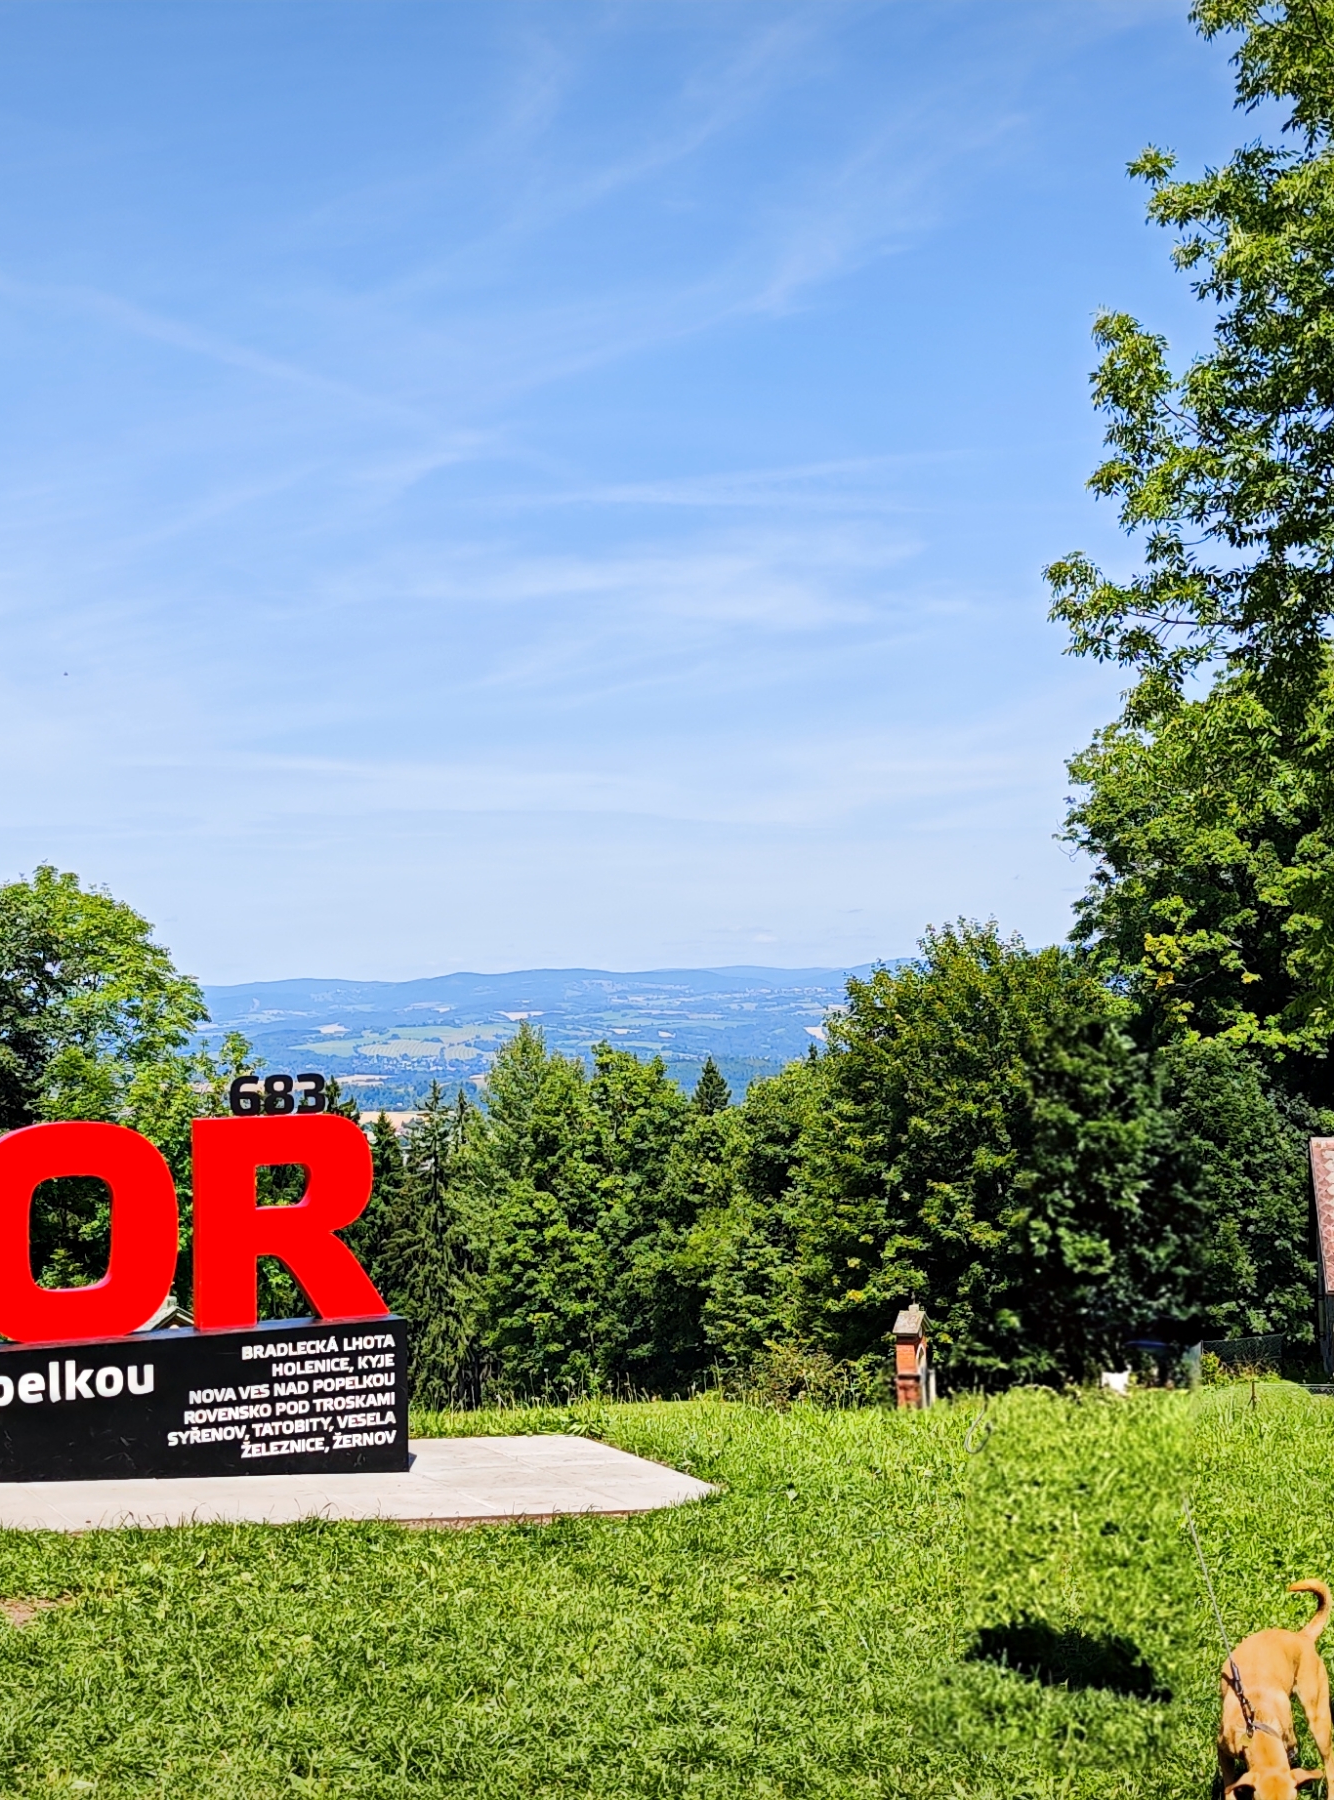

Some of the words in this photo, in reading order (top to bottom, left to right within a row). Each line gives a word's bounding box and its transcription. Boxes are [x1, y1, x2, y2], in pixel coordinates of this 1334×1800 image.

[230, 1073, 326, 1116] 683
[242, 1336, 339, 1361] BRADLECKÁ
[343, 1333, 396, 1352] LHOTA
[271, 1359, 354, 1377] HOLENICE,
[358, 1353, 396, 1370] KYJE
[189, 1387, 237, 1405] NOVA
[238, 1383, 270, 1400] VES
[273, 1381, 310, 1397] NAD
[313, 1372, 396, 1393] POPELKOU
[184, 1403, 272, 1425] ROVENSKO
[275, 1400, 310, 1417] POD
[313, 1392, 396, 1412] TROSKAMI
[167, 1424, 250, 1447] SYŘENOV,
[251, 1416, 335, 1438] TATOBITY,
[337, 1410, 396, 1429] VESELA
[241, 1436, 329, 1459] ŽELEZNICE,
[332, 1429, 397, 1450] ŽERNOV
